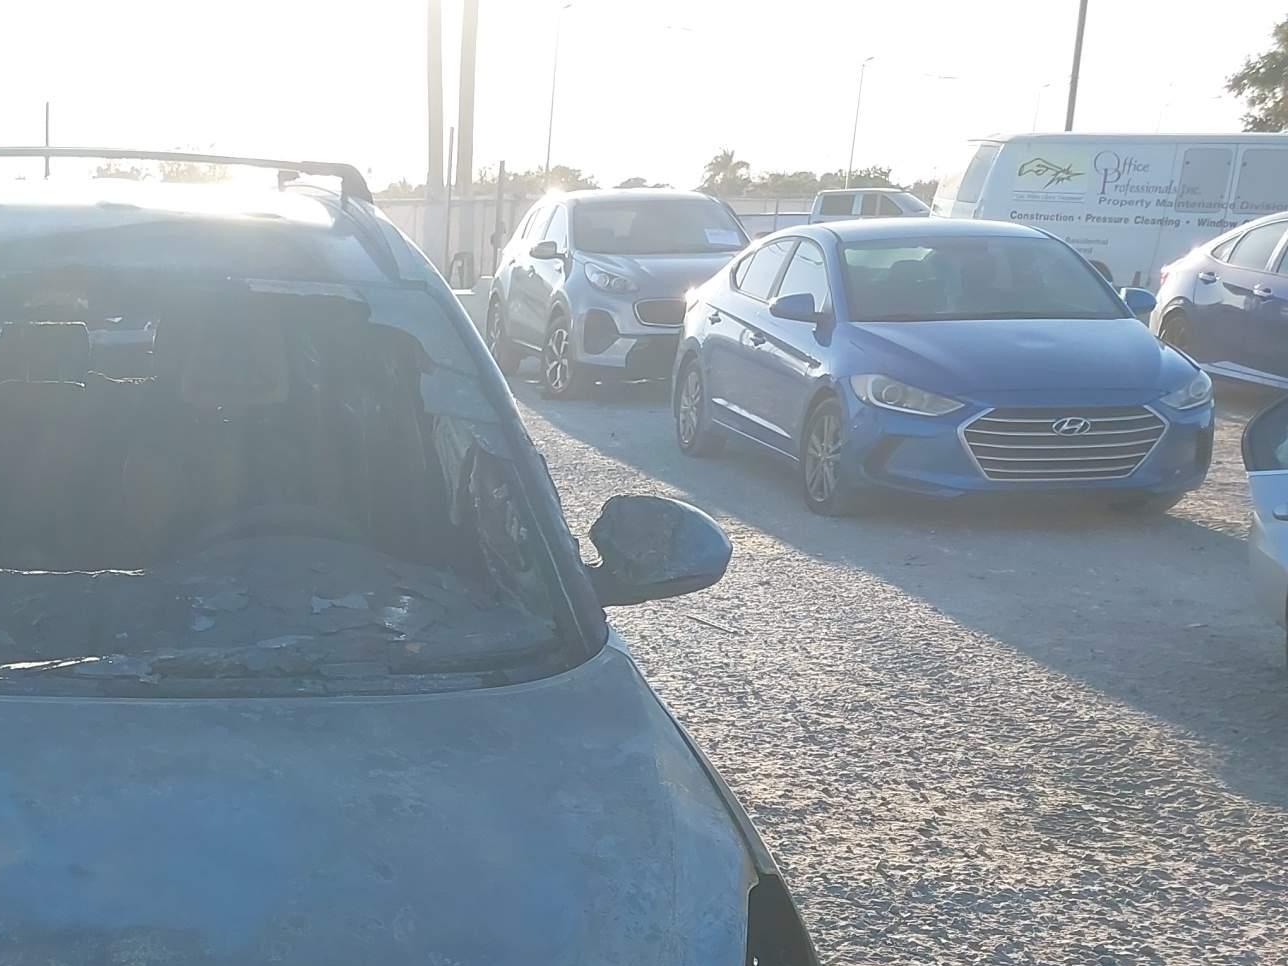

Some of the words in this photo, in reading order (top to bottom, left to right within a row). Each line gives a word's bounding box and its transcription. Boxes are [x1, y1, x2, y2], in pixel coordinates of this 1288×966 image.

[1094, 150, 1150, 175] Office
[1097, 168, 1178, 196] Professionals
[1098, 196, 1152, 208] Property
[1155, 197, 1236, 210] Maintenance
[1009, 210, 1075, 222] Construction
[1085, 213, 1130, 224] Pressure
[1134, 216, 1181, 227] Cleaning
[1197, 218, 1239, 228] Window
